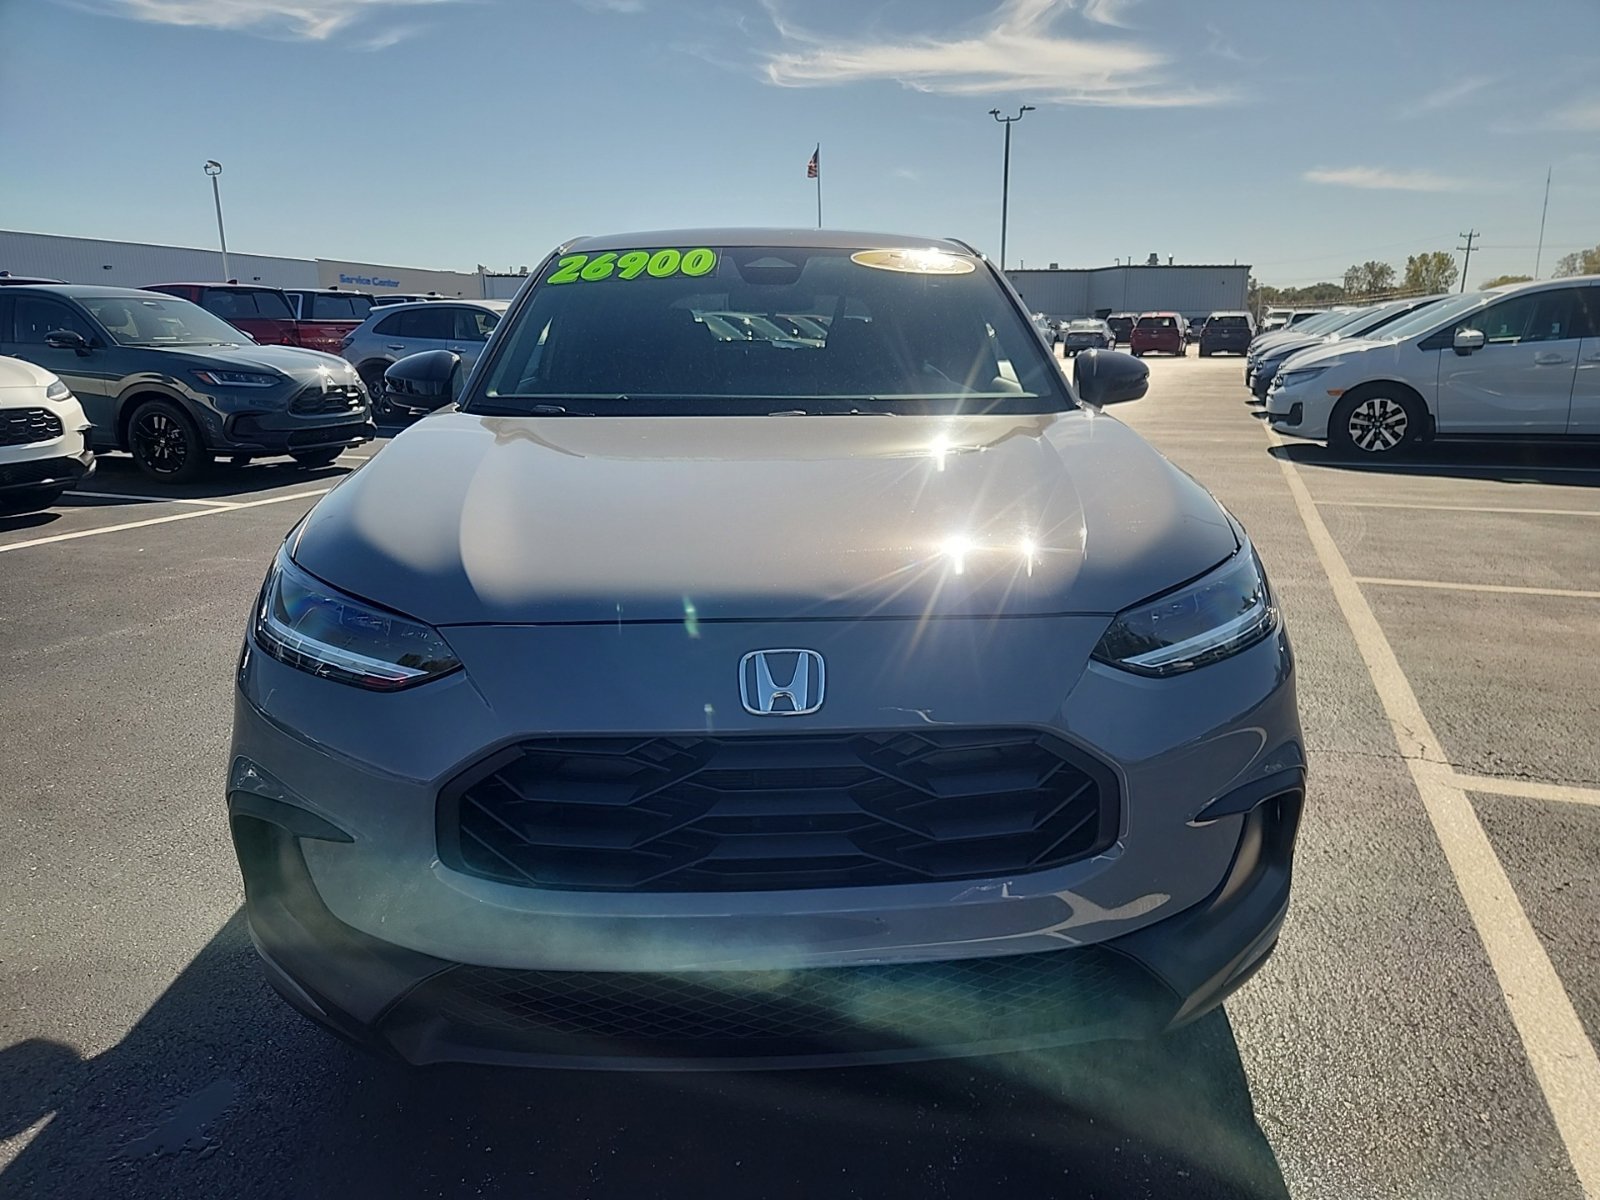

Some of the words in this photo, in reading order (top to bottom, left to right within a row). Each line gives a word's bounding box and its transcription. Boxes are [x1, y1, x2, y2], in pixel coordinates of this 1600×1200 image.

[547, 248, 716, 284] 26900
[339, 273, 371, 286] Service
[372, 277, 400, 288] Center
